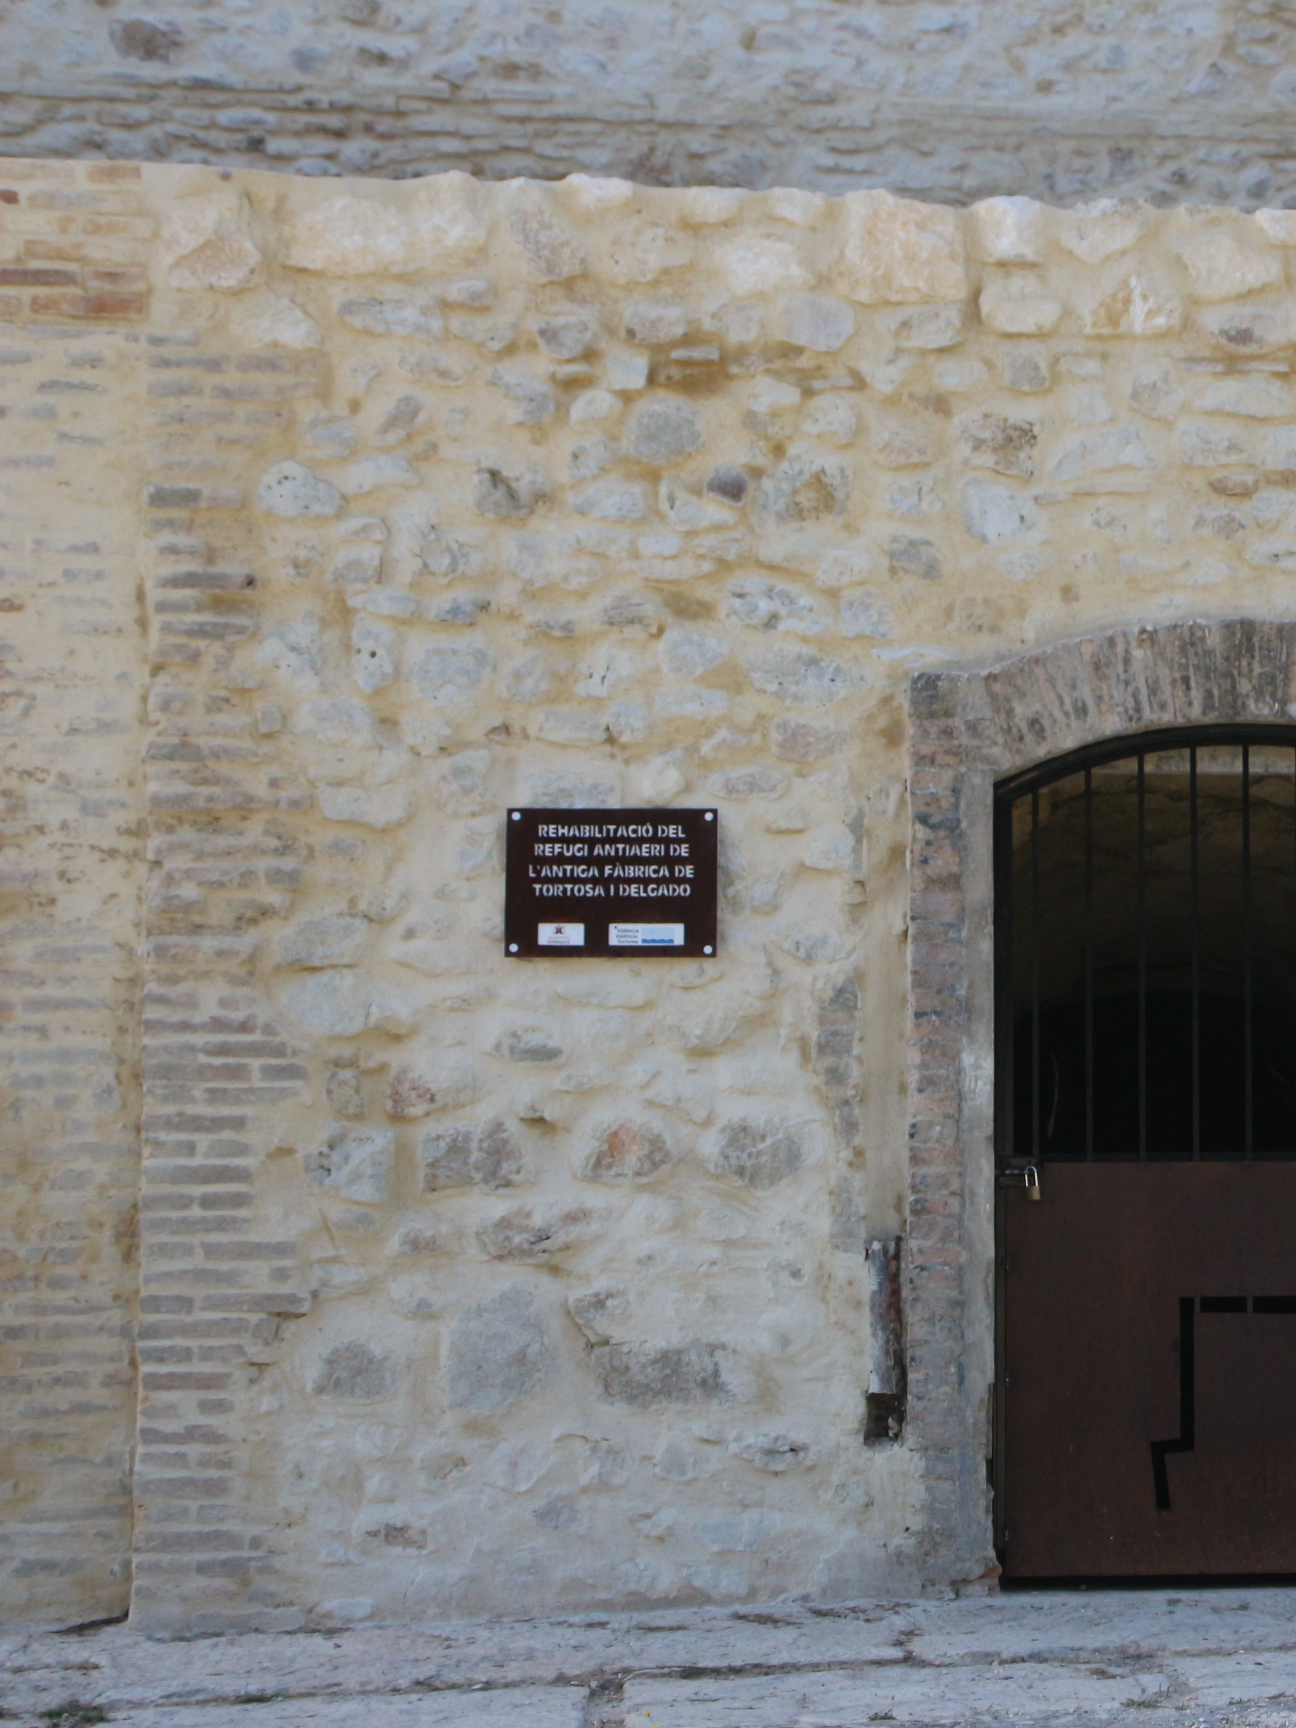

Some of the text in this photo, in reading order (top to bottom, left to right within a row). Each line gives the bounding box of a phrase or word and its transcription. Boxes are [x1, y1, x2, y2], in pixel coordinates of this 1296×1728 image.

[538, 822, 686, 838] REHABILITACIÓ DEL
[534, 843, 690, 857] REFUGI ANTIAERI DE
[528, 862, 695, 878] L'ANTIGA FÀBRICA DE
[532, 884, 691, 898] TORTOSA I DELGADO
